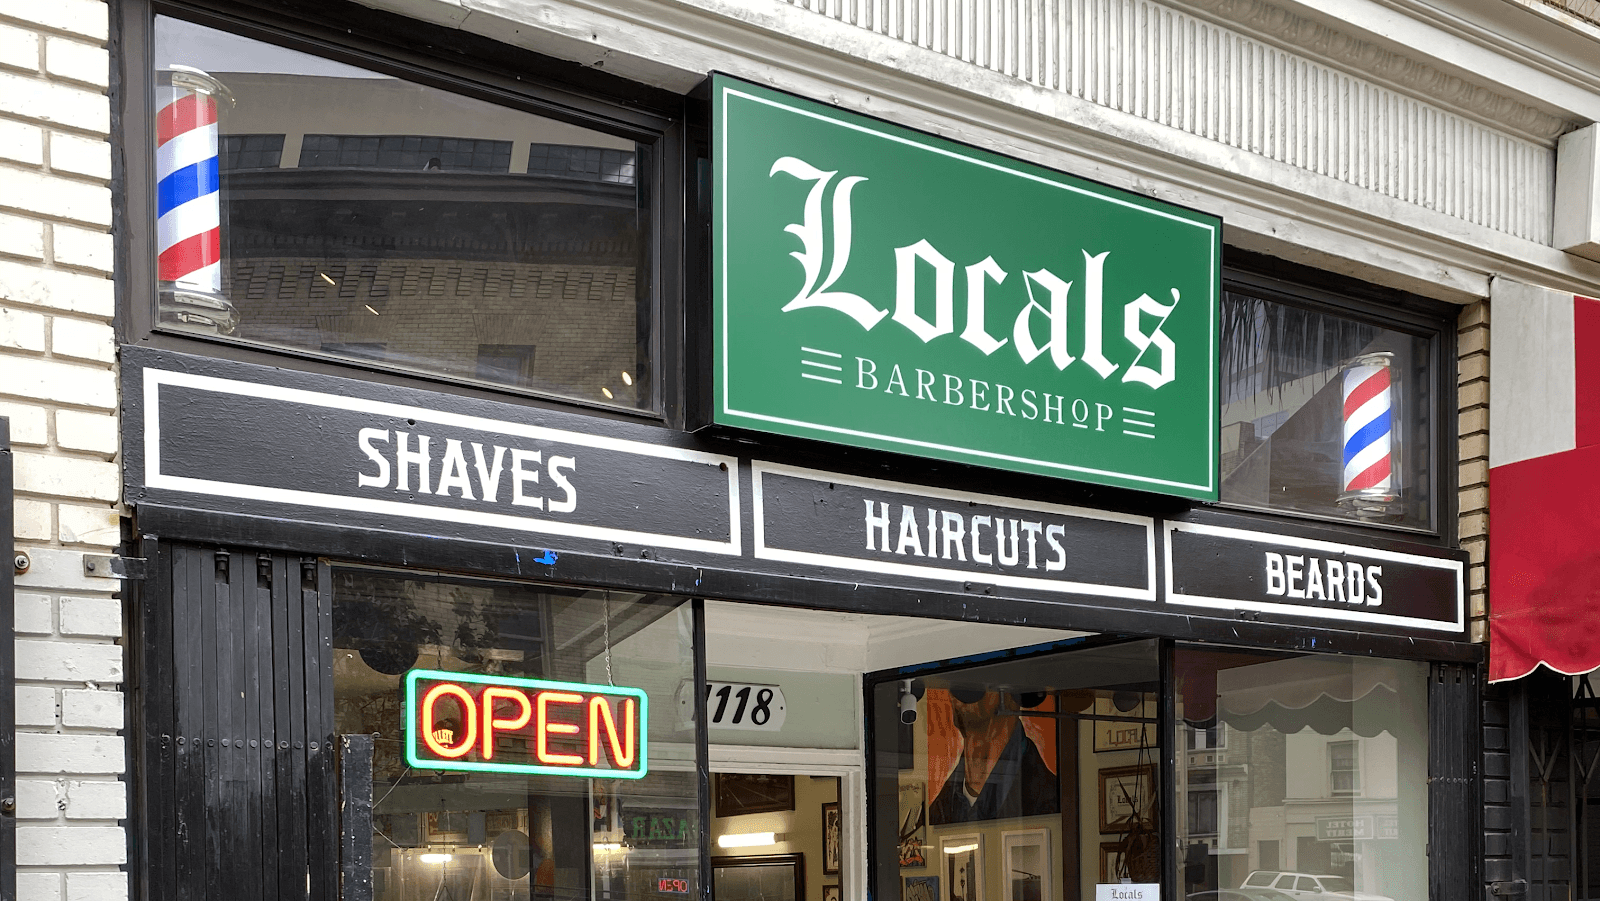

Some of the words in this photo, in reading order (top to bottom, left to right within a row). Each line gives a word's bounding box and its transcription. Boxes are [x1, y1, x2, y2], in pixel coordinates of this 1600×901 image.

[769, 156, 1181, 390] Locals
[855, 356, 1114, 432] BARBERSHOP
[358, 427, 577, 513] SHAVES
[863, 499, 1067, 572] HAIRCUTS
[1265, 551, 1383, 607] BEARDS
[420, 683, 635, 768] OPEN
[1111, 888, 1143, 900] Locals
